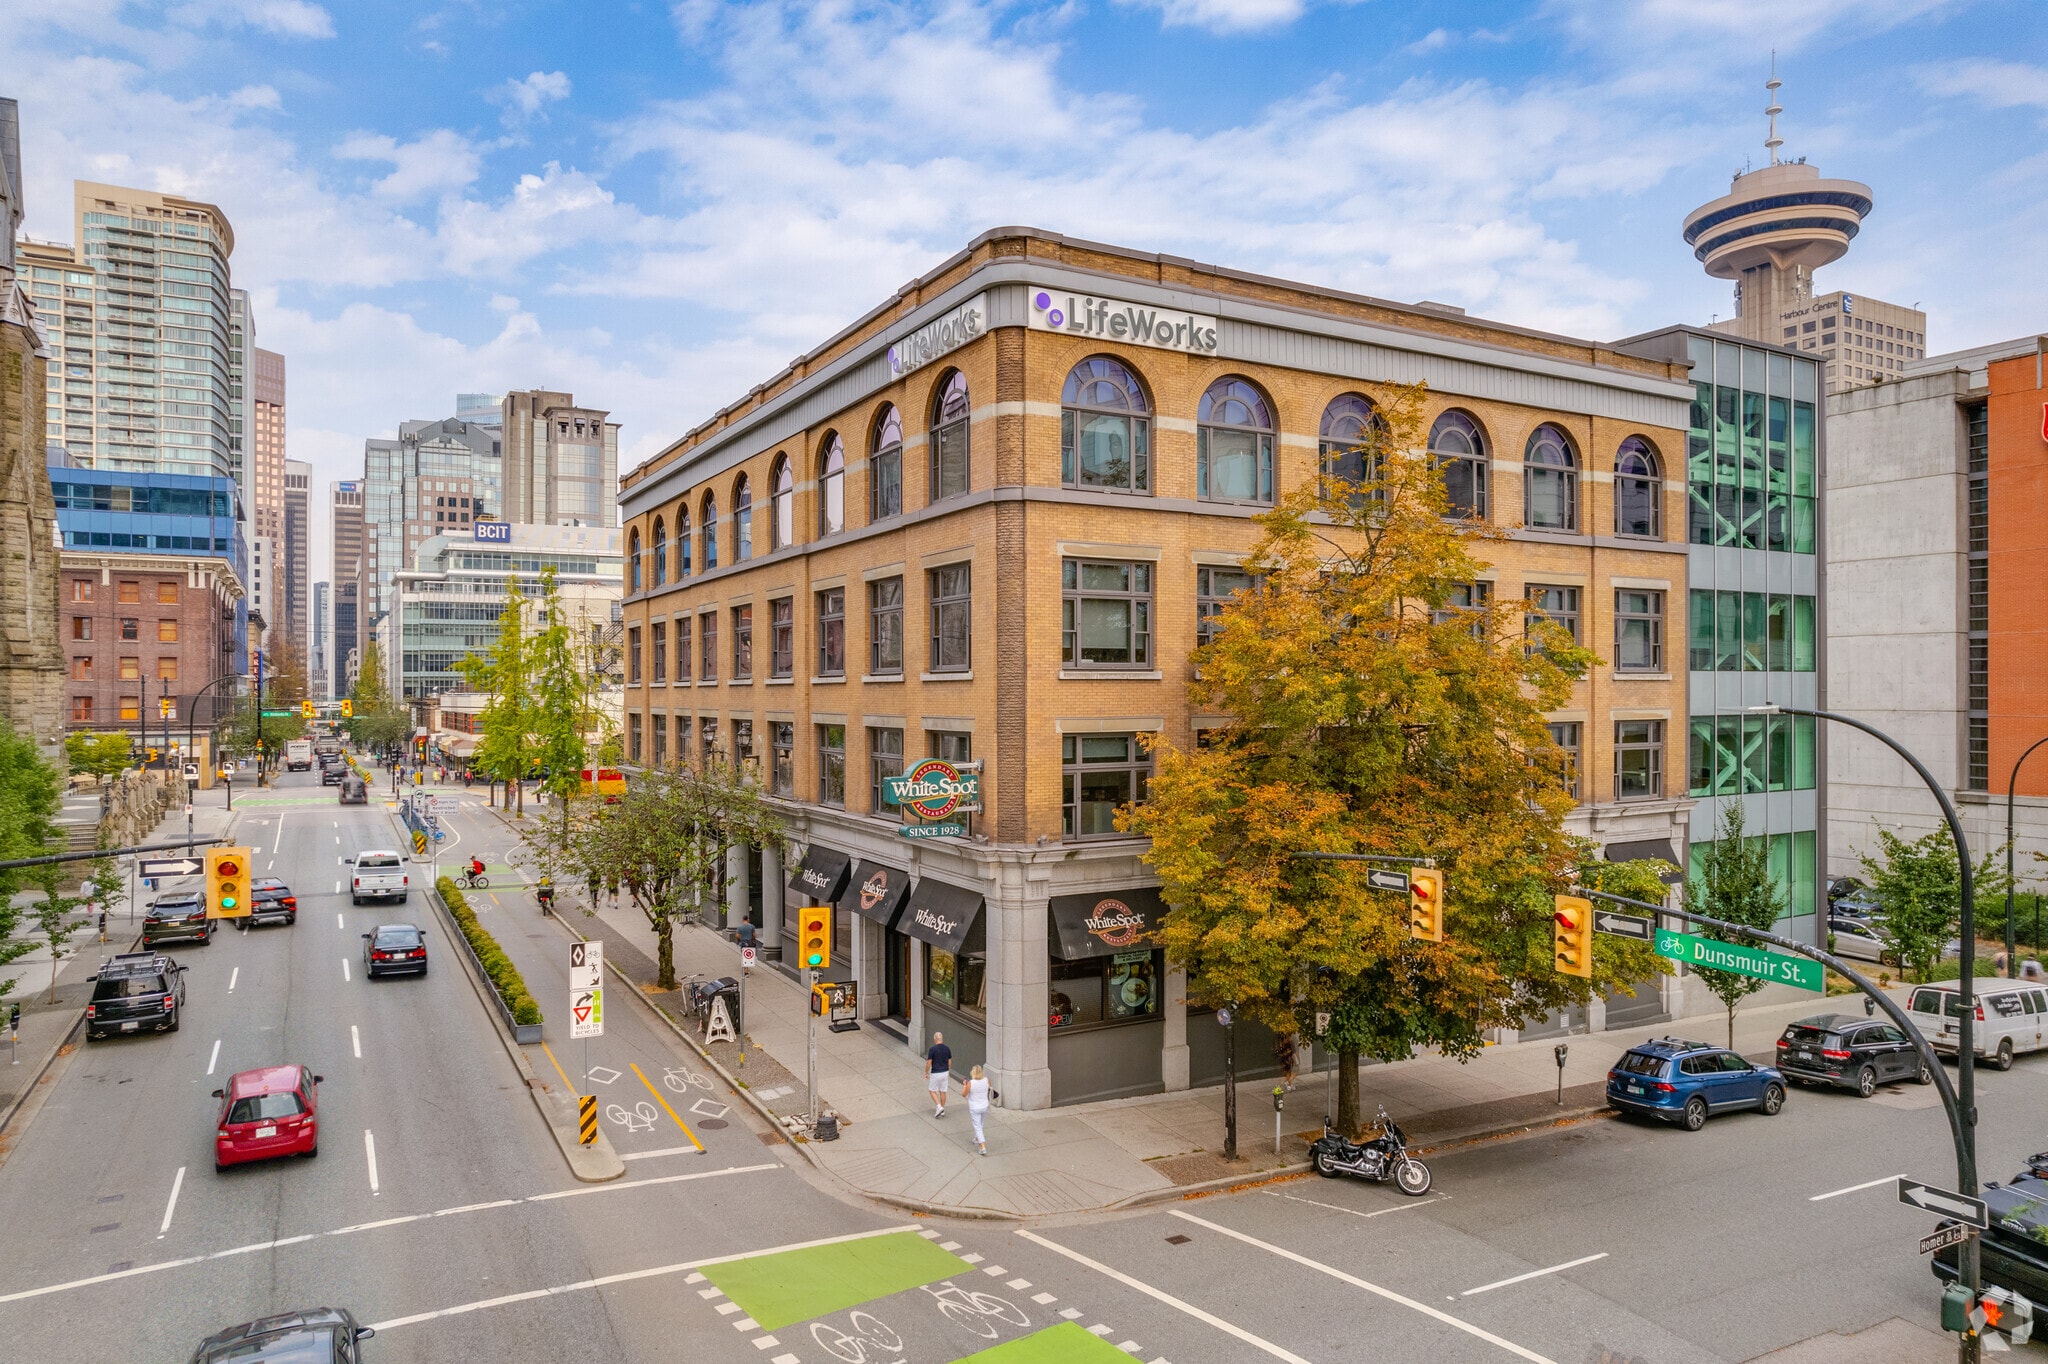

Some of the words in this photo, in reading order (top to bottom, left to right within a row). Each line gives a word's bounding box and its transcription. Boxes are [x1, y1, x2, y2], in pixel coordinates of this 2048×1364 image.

[1779, 308, 1809, 321] Harbour
[1812, 301, 1838, 312] Centre
[1067, 297, 1218, 351] LifeWorks
[899, 306, 982, 370] LifeWorks
[477, 524, 508, 539] BCIT
[915, 764, 955, 779] LEGENDARY
[915, 796, 957, 816] RESTAURANT
[909, 827, 938, 837] SINCE
[941, 826, 960, 835] 1928
[1694, 942, 1777, 976] Dunsmuir
[1781, 961, 1807, 984] St.
[1050, 1013, 1073, 1025] OPEN
[1920, 1235, 1945, 1253] Homer
